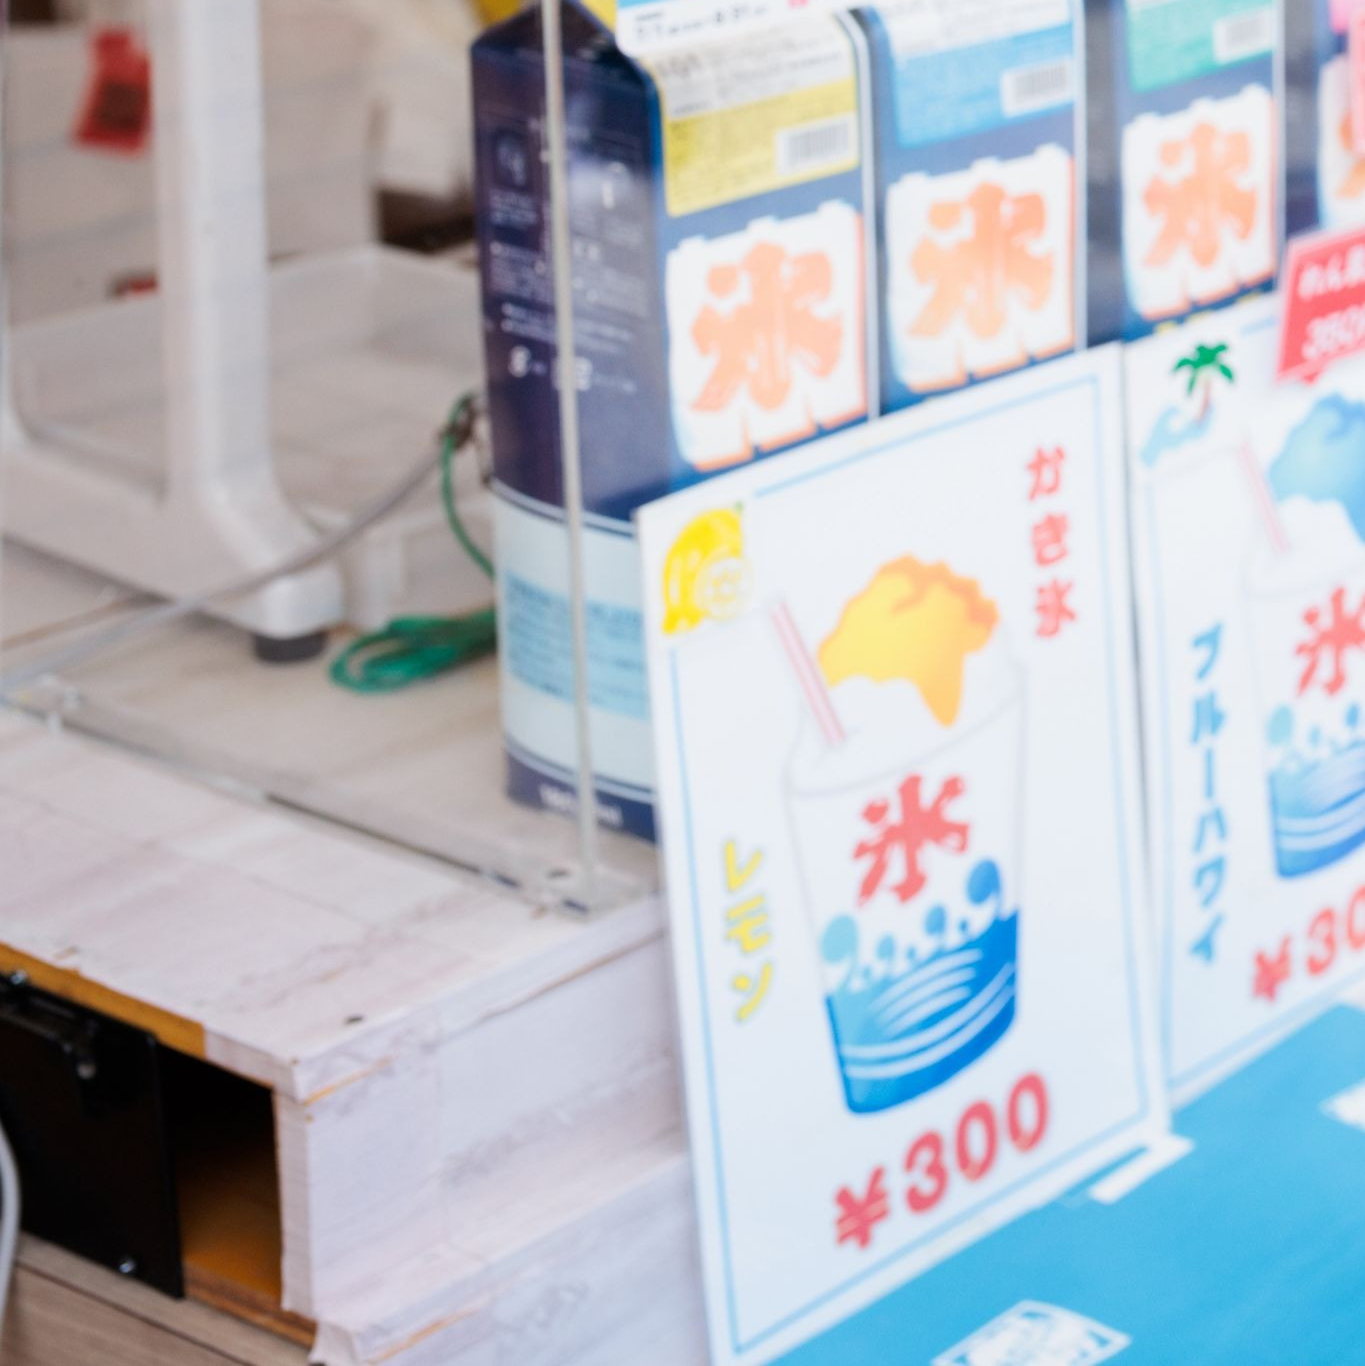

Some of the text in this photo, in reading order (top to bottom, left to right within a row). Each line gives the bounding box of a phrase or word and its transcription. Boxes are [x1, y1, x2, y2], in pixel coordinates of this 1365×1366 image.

[910, 181, 1054, 340] 氷
[1142, 121, 1259, 268] 氷
[689, 241, 845, 413] 氷
[1024, 445, 1077, 640] かき氷
[851, 773, 971, 908] 氷
[722, 838, 773, 1023] レモン
[833, 1070, 1050, 1250] ¥300
